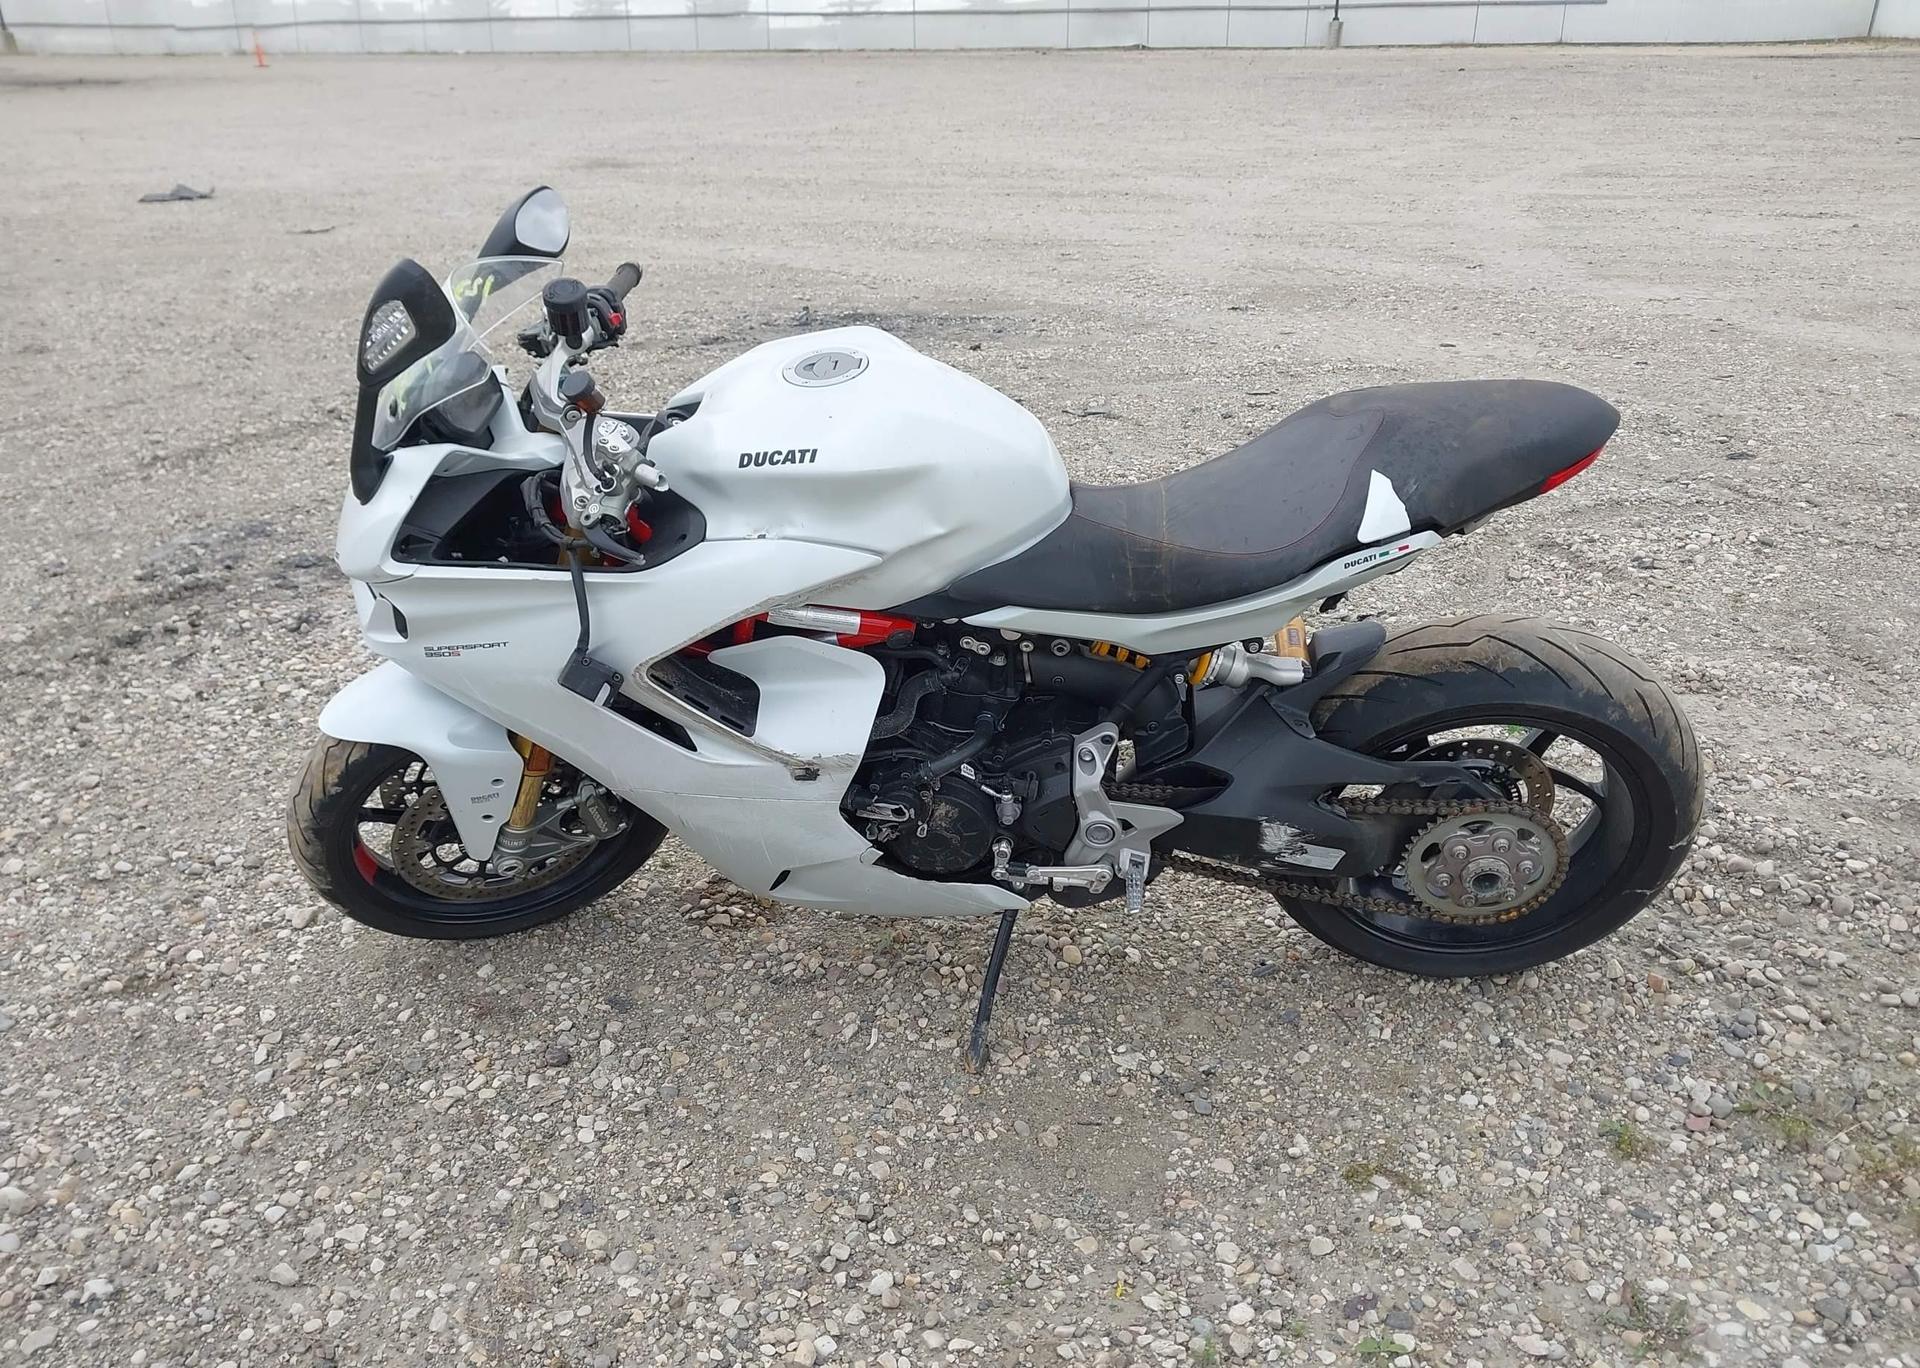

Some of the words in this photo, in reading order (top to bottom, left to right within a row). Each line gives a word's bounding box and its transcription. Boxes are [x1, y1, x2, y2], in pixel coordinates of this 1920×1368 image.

[738, 448, 818, 469] DUCATI
[1343, 553, 1377, 569] DUCATI
[423, 641, 509, 652] SUPERSPORT
